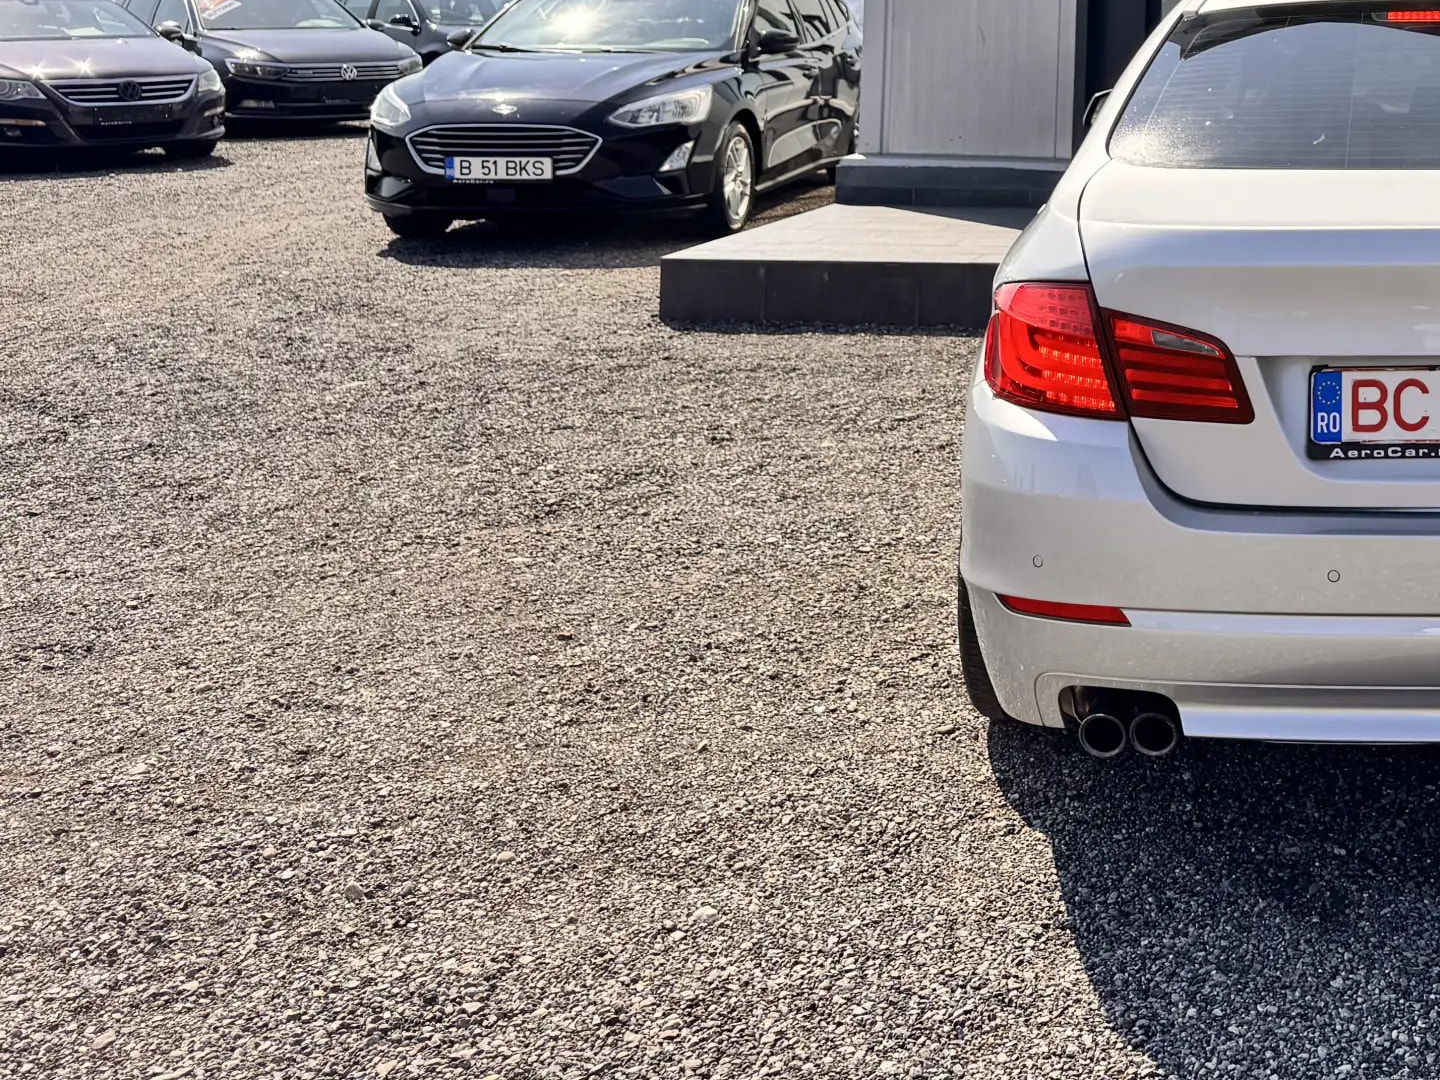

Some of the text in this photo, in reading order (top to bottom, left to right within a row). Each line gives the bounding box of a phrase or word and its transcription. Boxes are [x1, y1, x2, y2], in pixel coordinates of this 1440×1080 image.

[459, 159, 472, 176] B
[481, 160, 498, 176] 51
[505, 160, 545, 177] BKS
[1350, 378, 1430, 433] BC
[1317, 411, 1341, 433] RO
